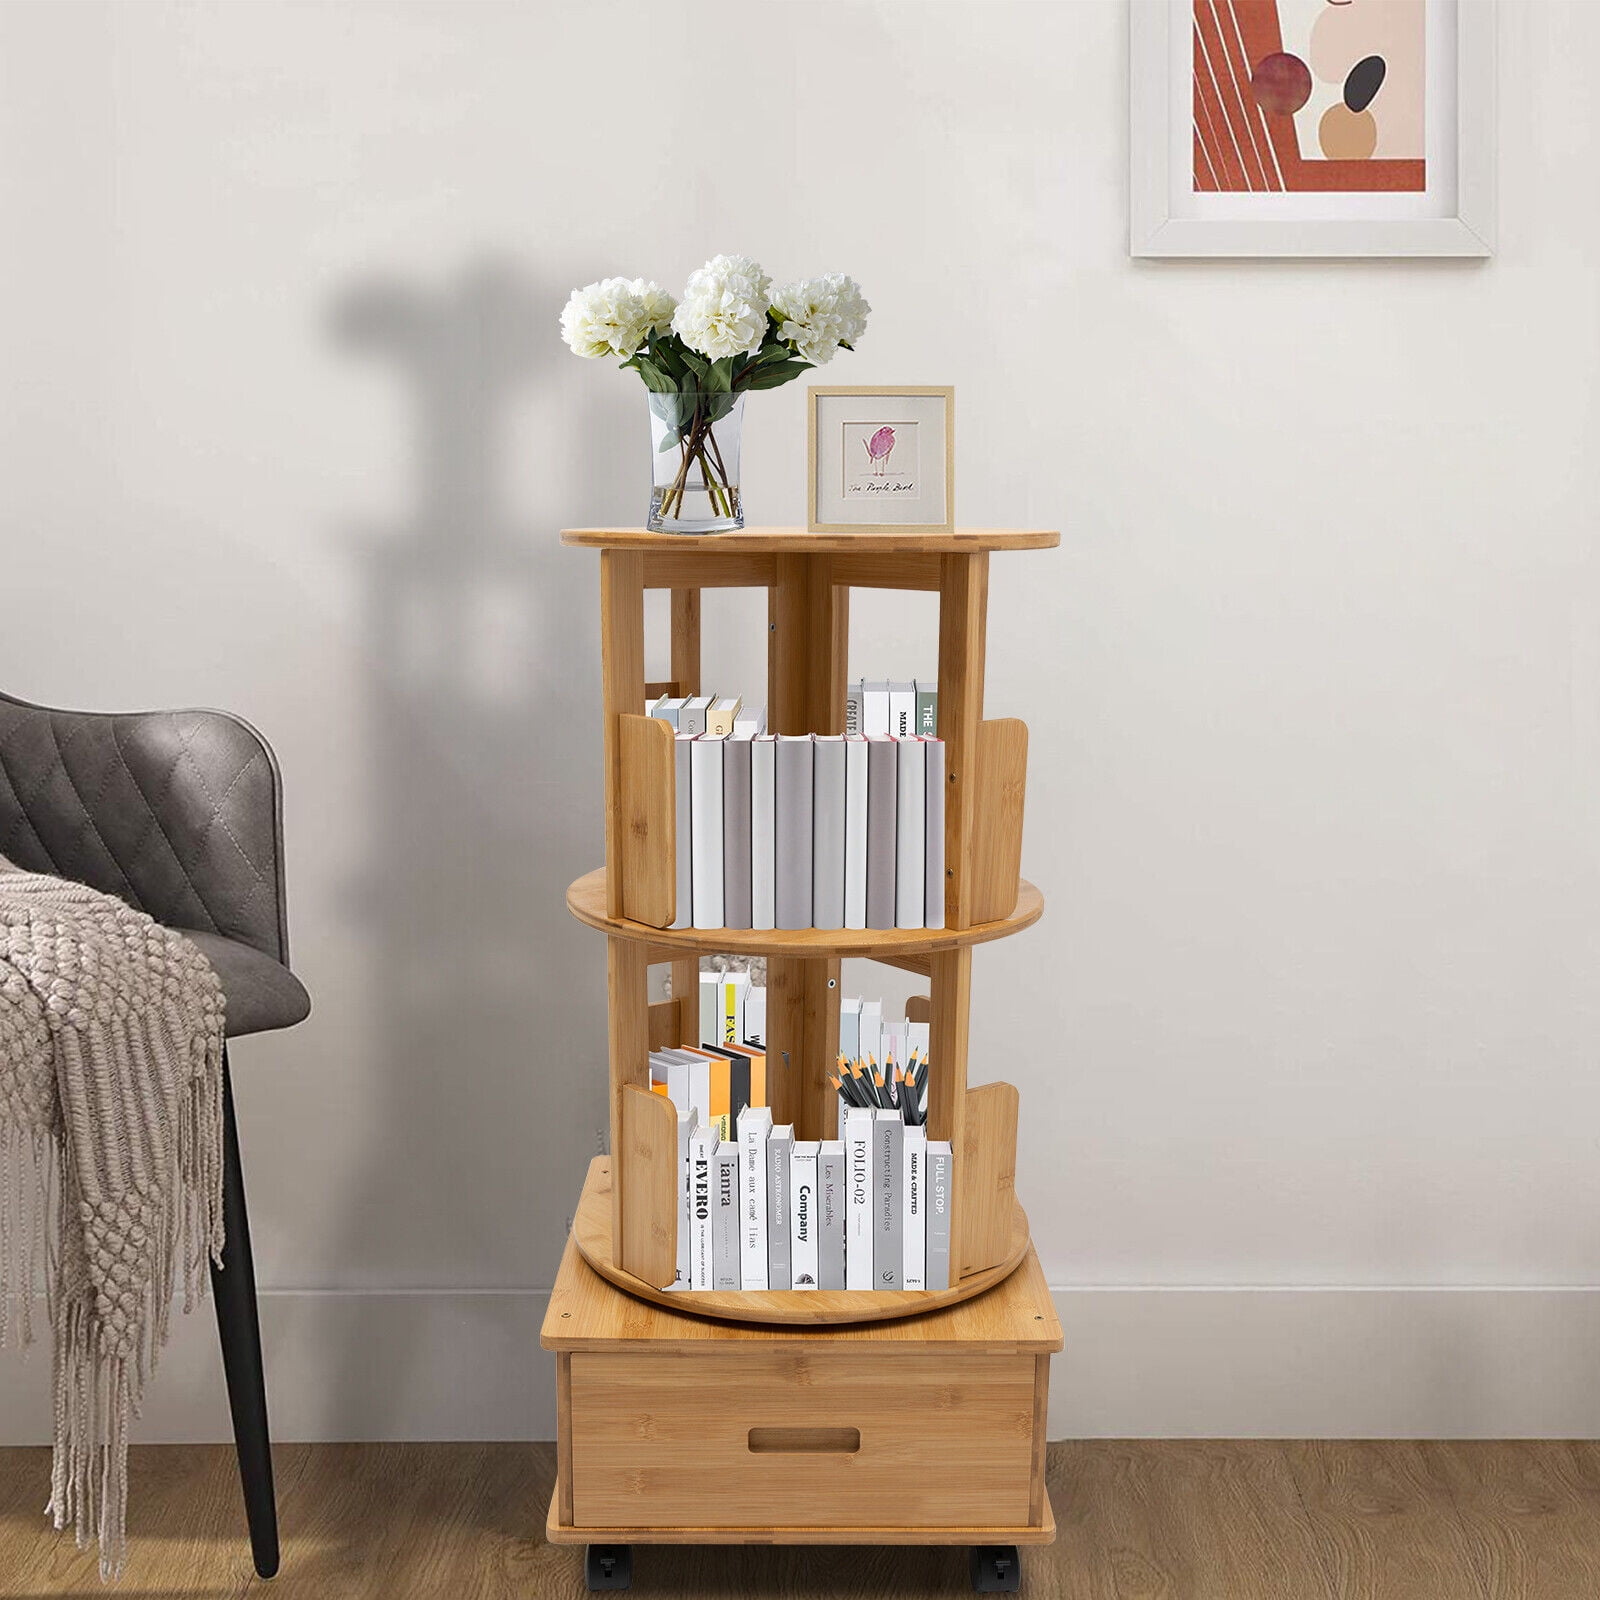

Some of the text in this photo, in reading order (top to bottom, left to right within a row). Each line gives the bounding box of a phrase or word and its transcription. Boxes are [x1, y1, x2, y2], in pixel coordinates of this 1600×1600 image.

[899, 711, 907, 738] MADE
[923, 704, 933, 727] THE
[748, 1132, 758, 1144] La
[748, 1149, 758, 1172] Dame
[883, 1129, 893, 1188] Constructing
[695, 1160, 709, 1220] EVERO
[719, 1162, 735, 1207] ianra
[748, 1176, 757, 1194] aux
[774, 1148, 783, 1226] RADIO ASTRONOMER
[853, 1140, 866, 1205] FOLIO-02
[935, 1156, 945, 1215] FULL STOP.
[797, 1185, 811, 1242] Company
